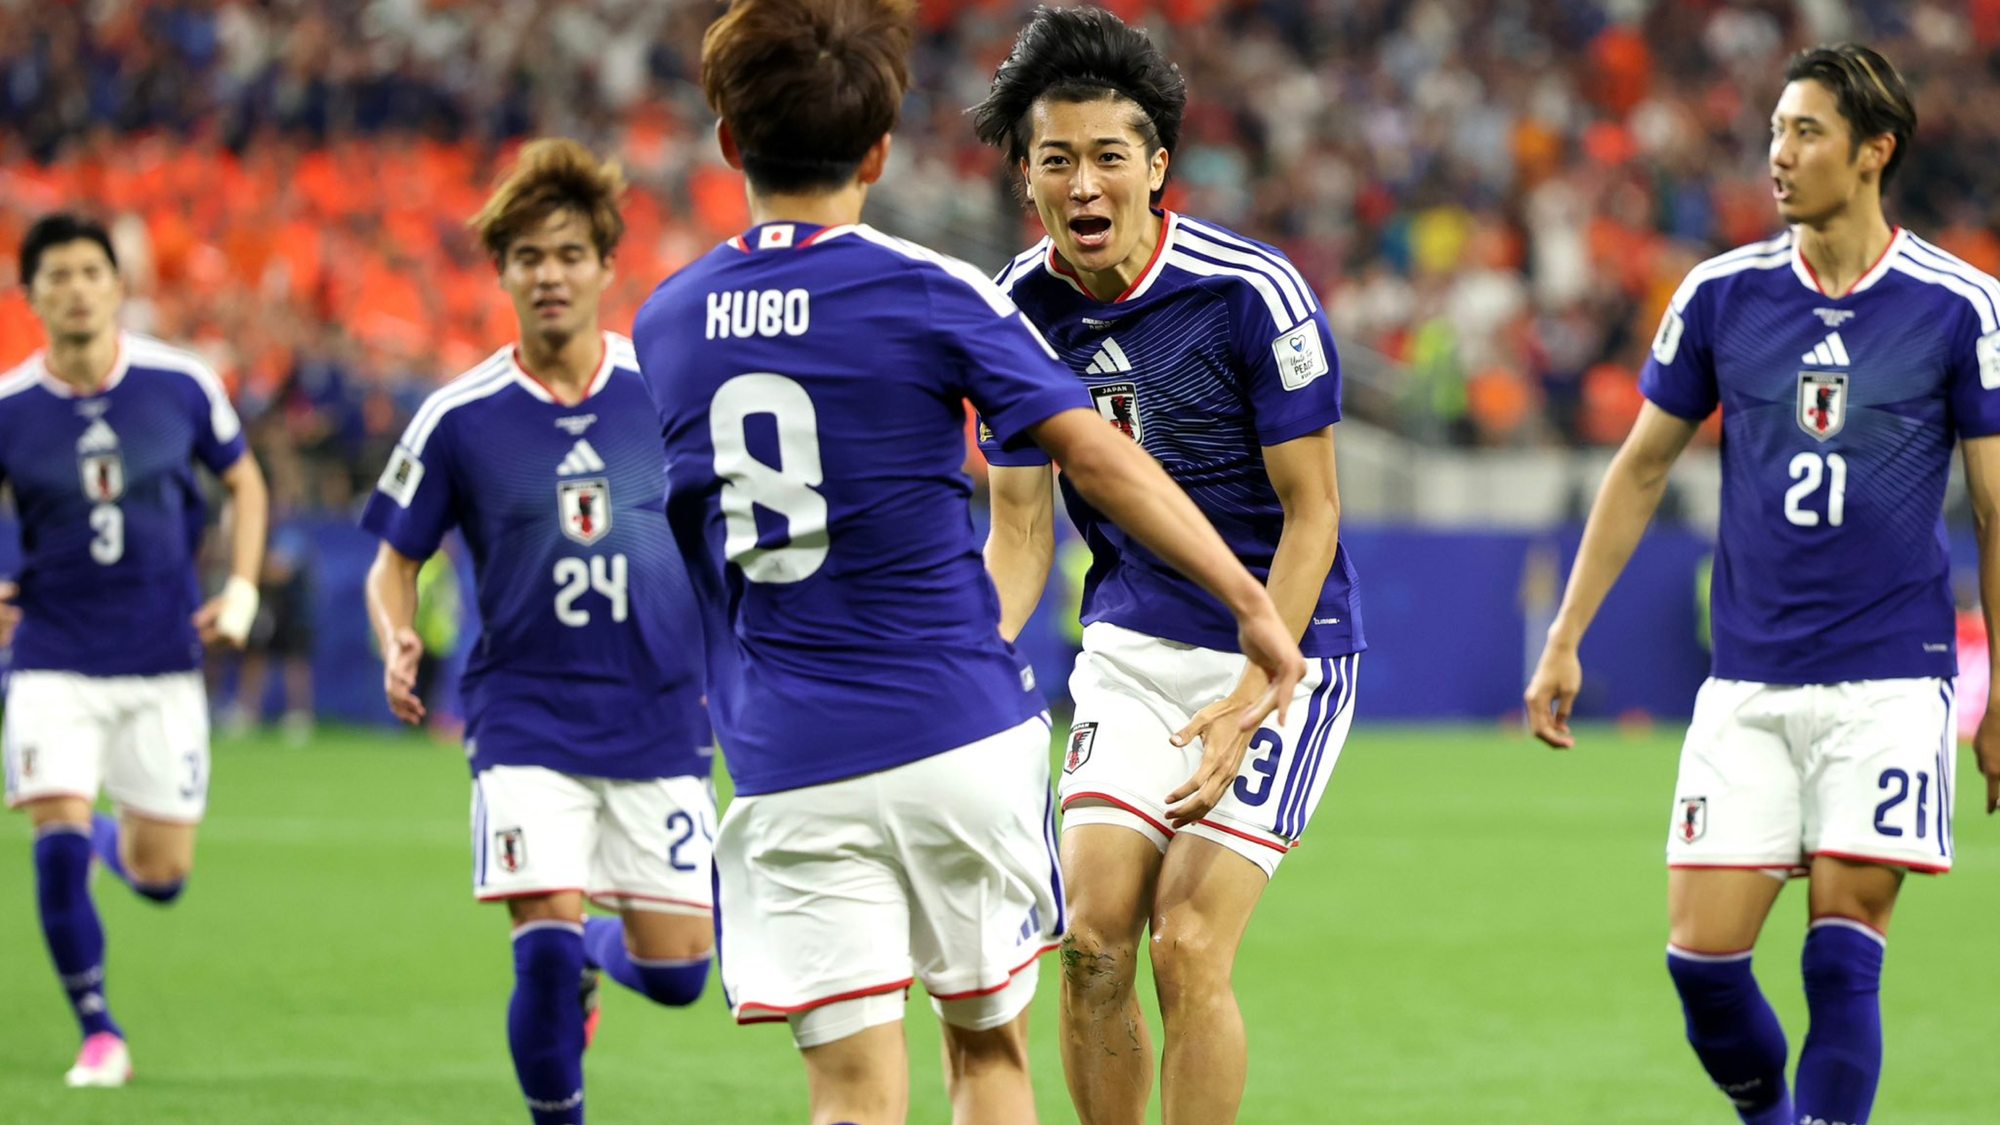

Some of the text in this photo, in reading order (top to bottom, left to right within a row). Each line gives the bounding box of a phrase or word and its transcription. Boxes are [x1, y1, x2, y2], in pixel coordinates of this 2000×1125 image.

[705, 288, 810, 340] KUBO
[1102, 385, 1128, 394] JAPAN
[1294, 358, 1314, 376] PEACE
[710, 372, 830, 583] 8
[1784, 451, 1847, 527] 21
[88, 503, 125, 565] 3
[553, 553, 629, 627] 24
[1873, 768, 1929, 839] 21
[667, 810, 713, 871] 2
